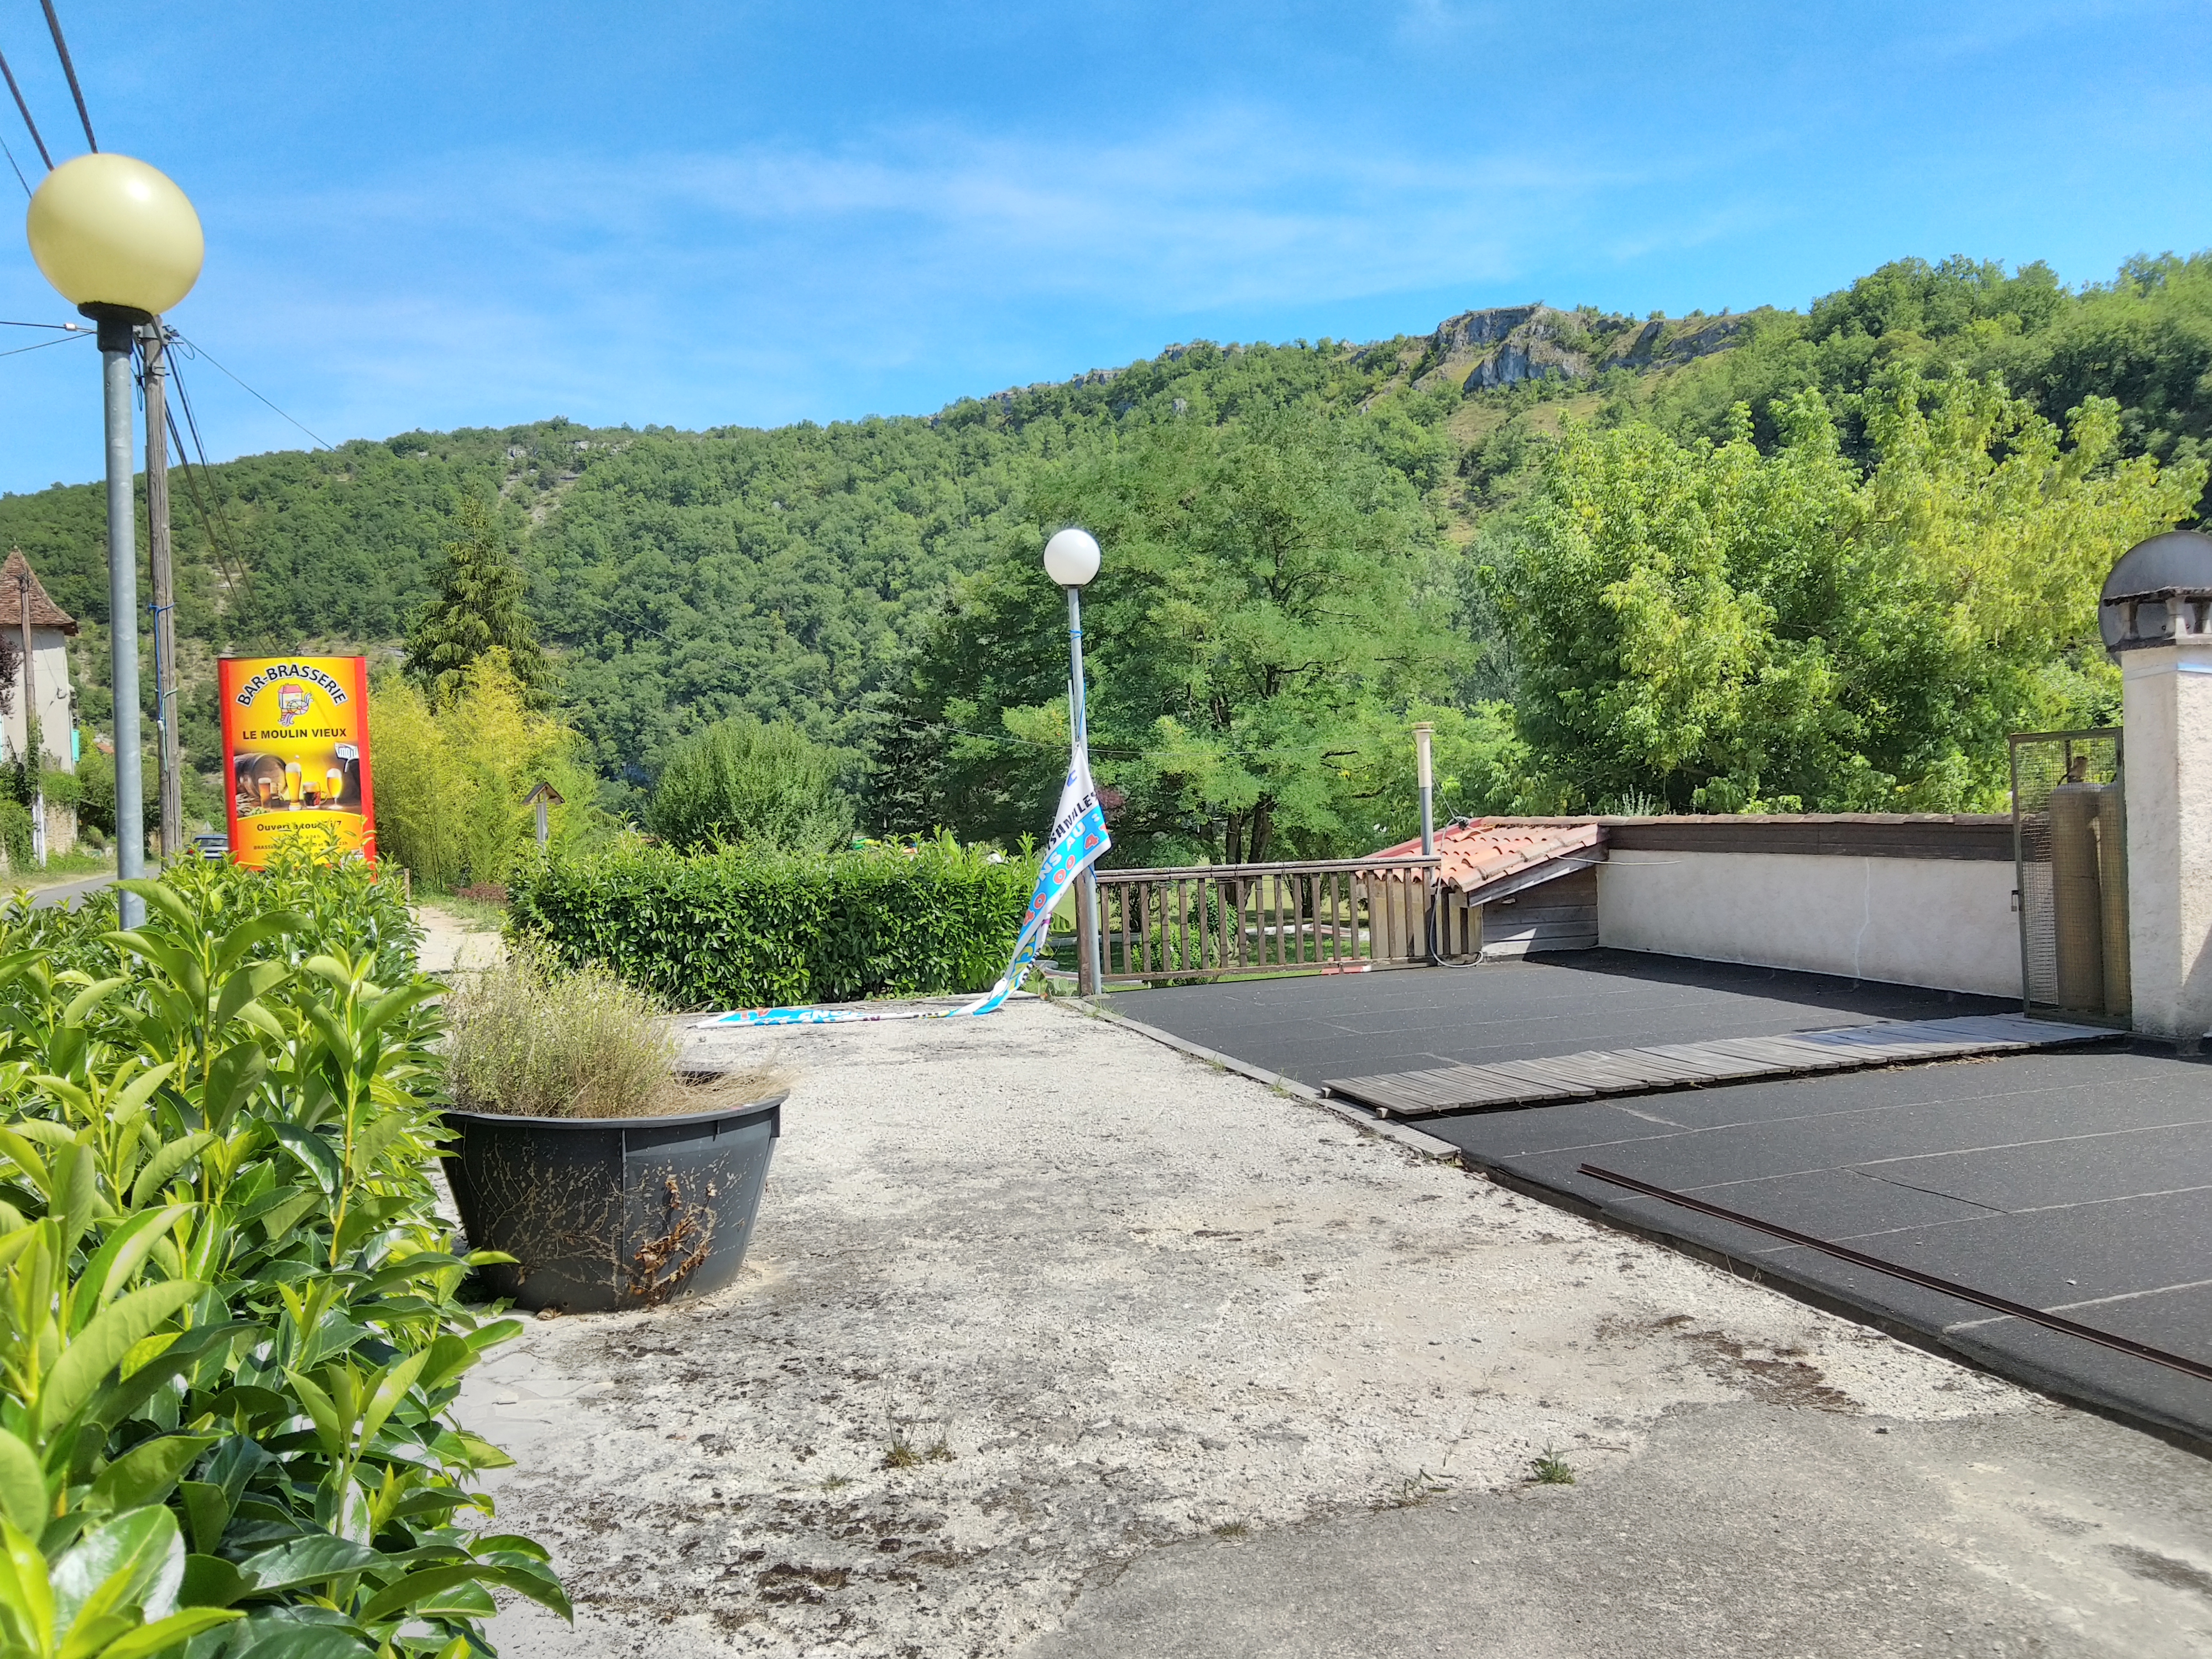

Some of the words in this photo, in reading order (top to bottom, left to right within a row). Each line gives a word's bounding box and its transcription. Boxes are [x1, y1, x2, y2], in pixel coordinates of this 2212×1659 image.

[237, 664, 347, 706] BAR-BRASSERIE
[243, 731, 257, 739] LE
[261, 729, 307, 739] MOULIN
[311, 728, 347, 737] VIEUX
